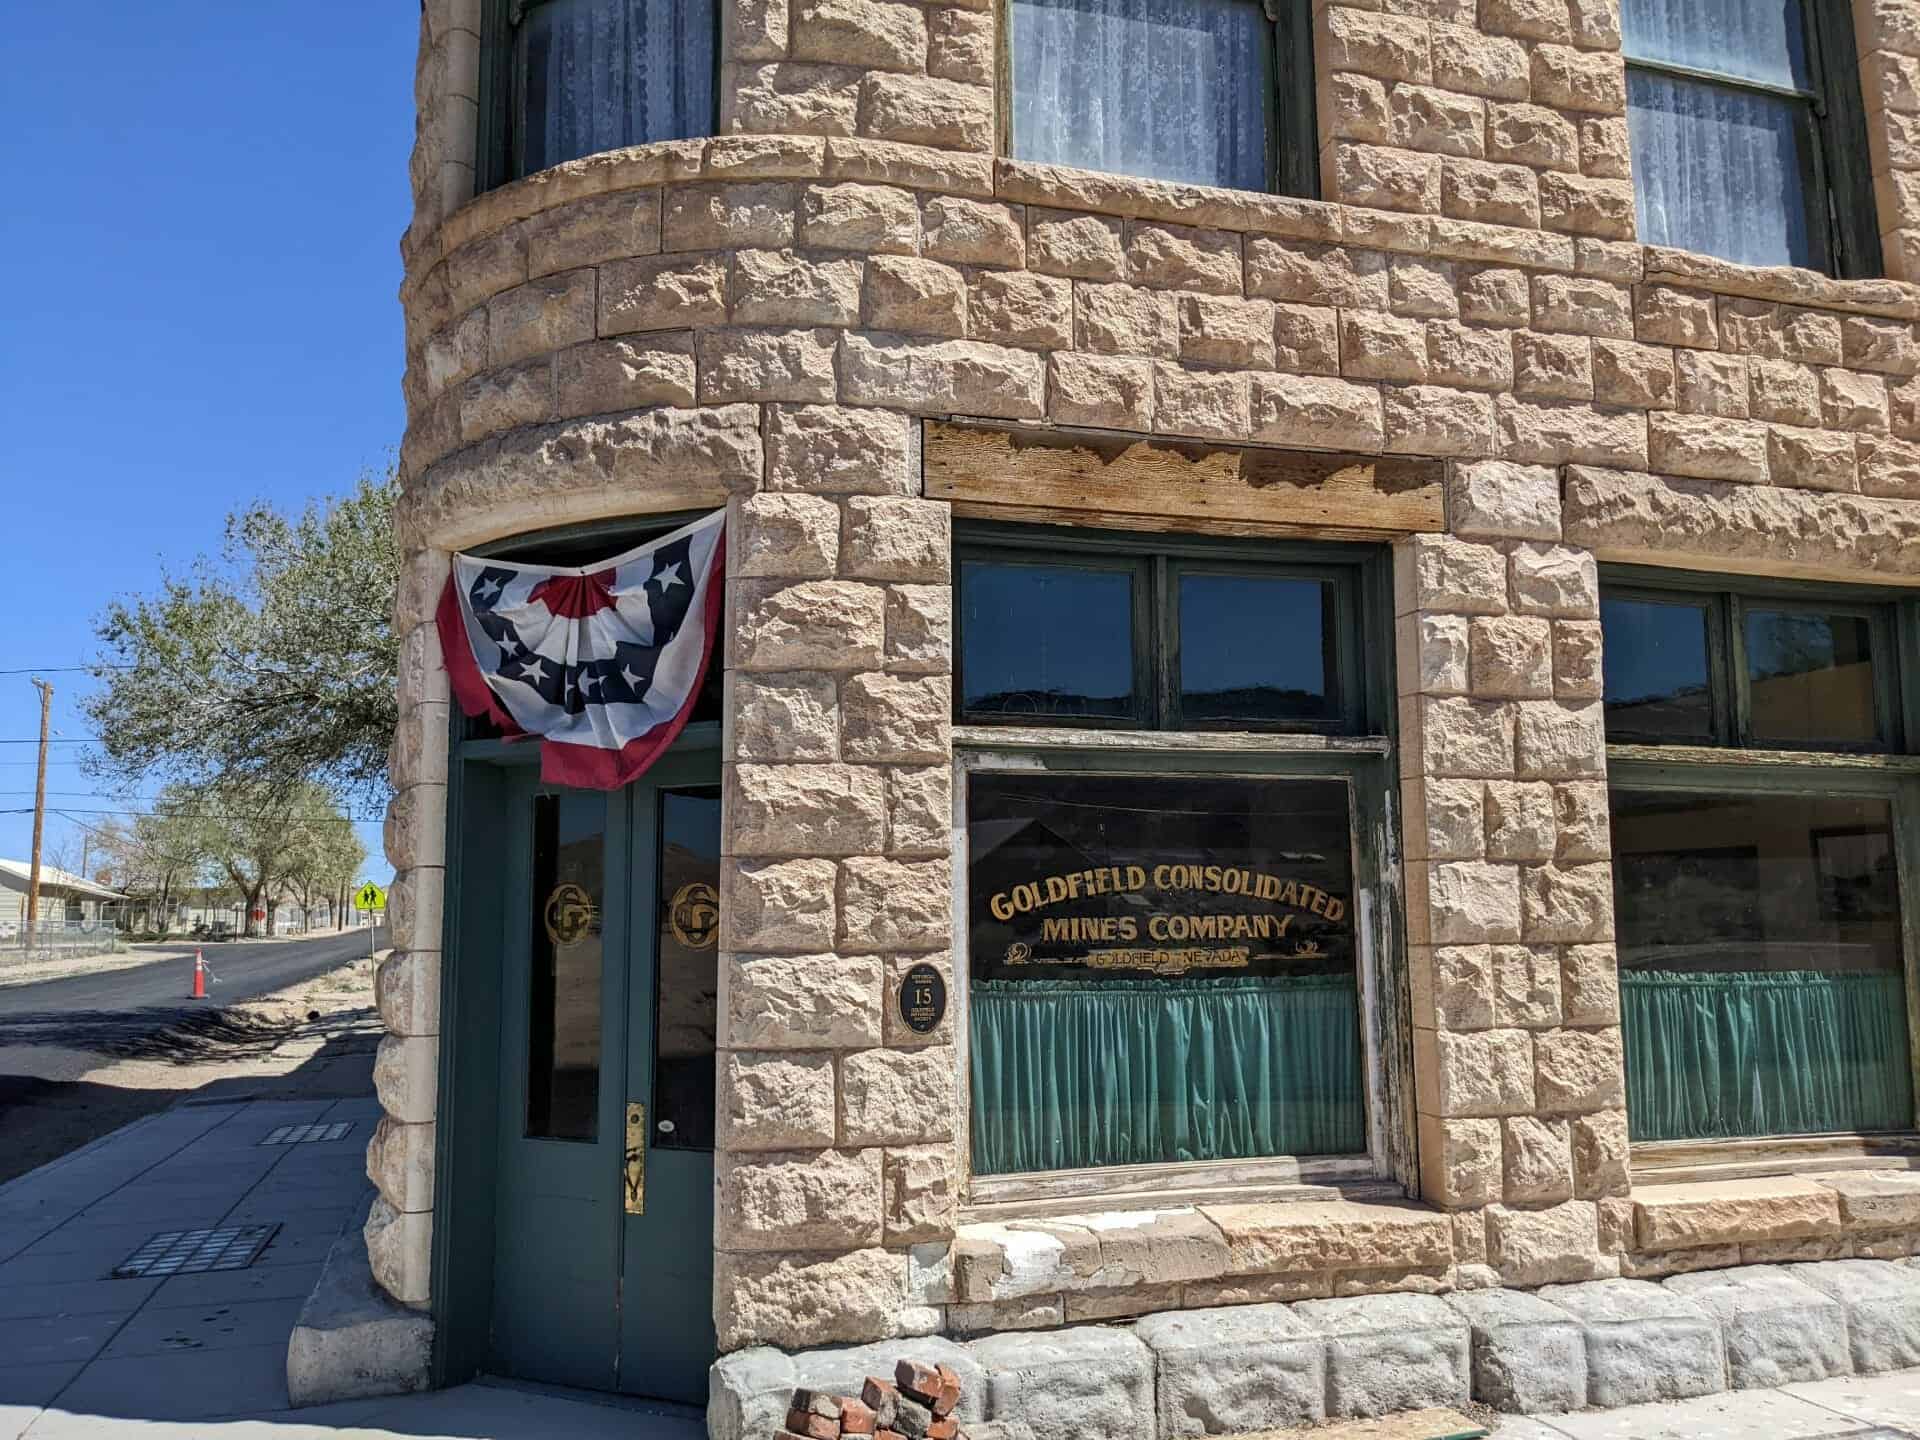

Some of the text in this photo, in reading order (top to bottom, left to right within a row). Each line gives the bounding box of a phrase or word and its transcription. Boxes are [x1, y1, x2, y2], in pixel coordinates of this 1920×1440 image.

[990, 864, 1345, 922] GOLDFIELD CONSOLIDATED
[1043, 914, 1295, 942] MINES COMPANY
[1095, 951, 1170, 965] GOLDFIELD
[915, 987, 932, 1005] 15
